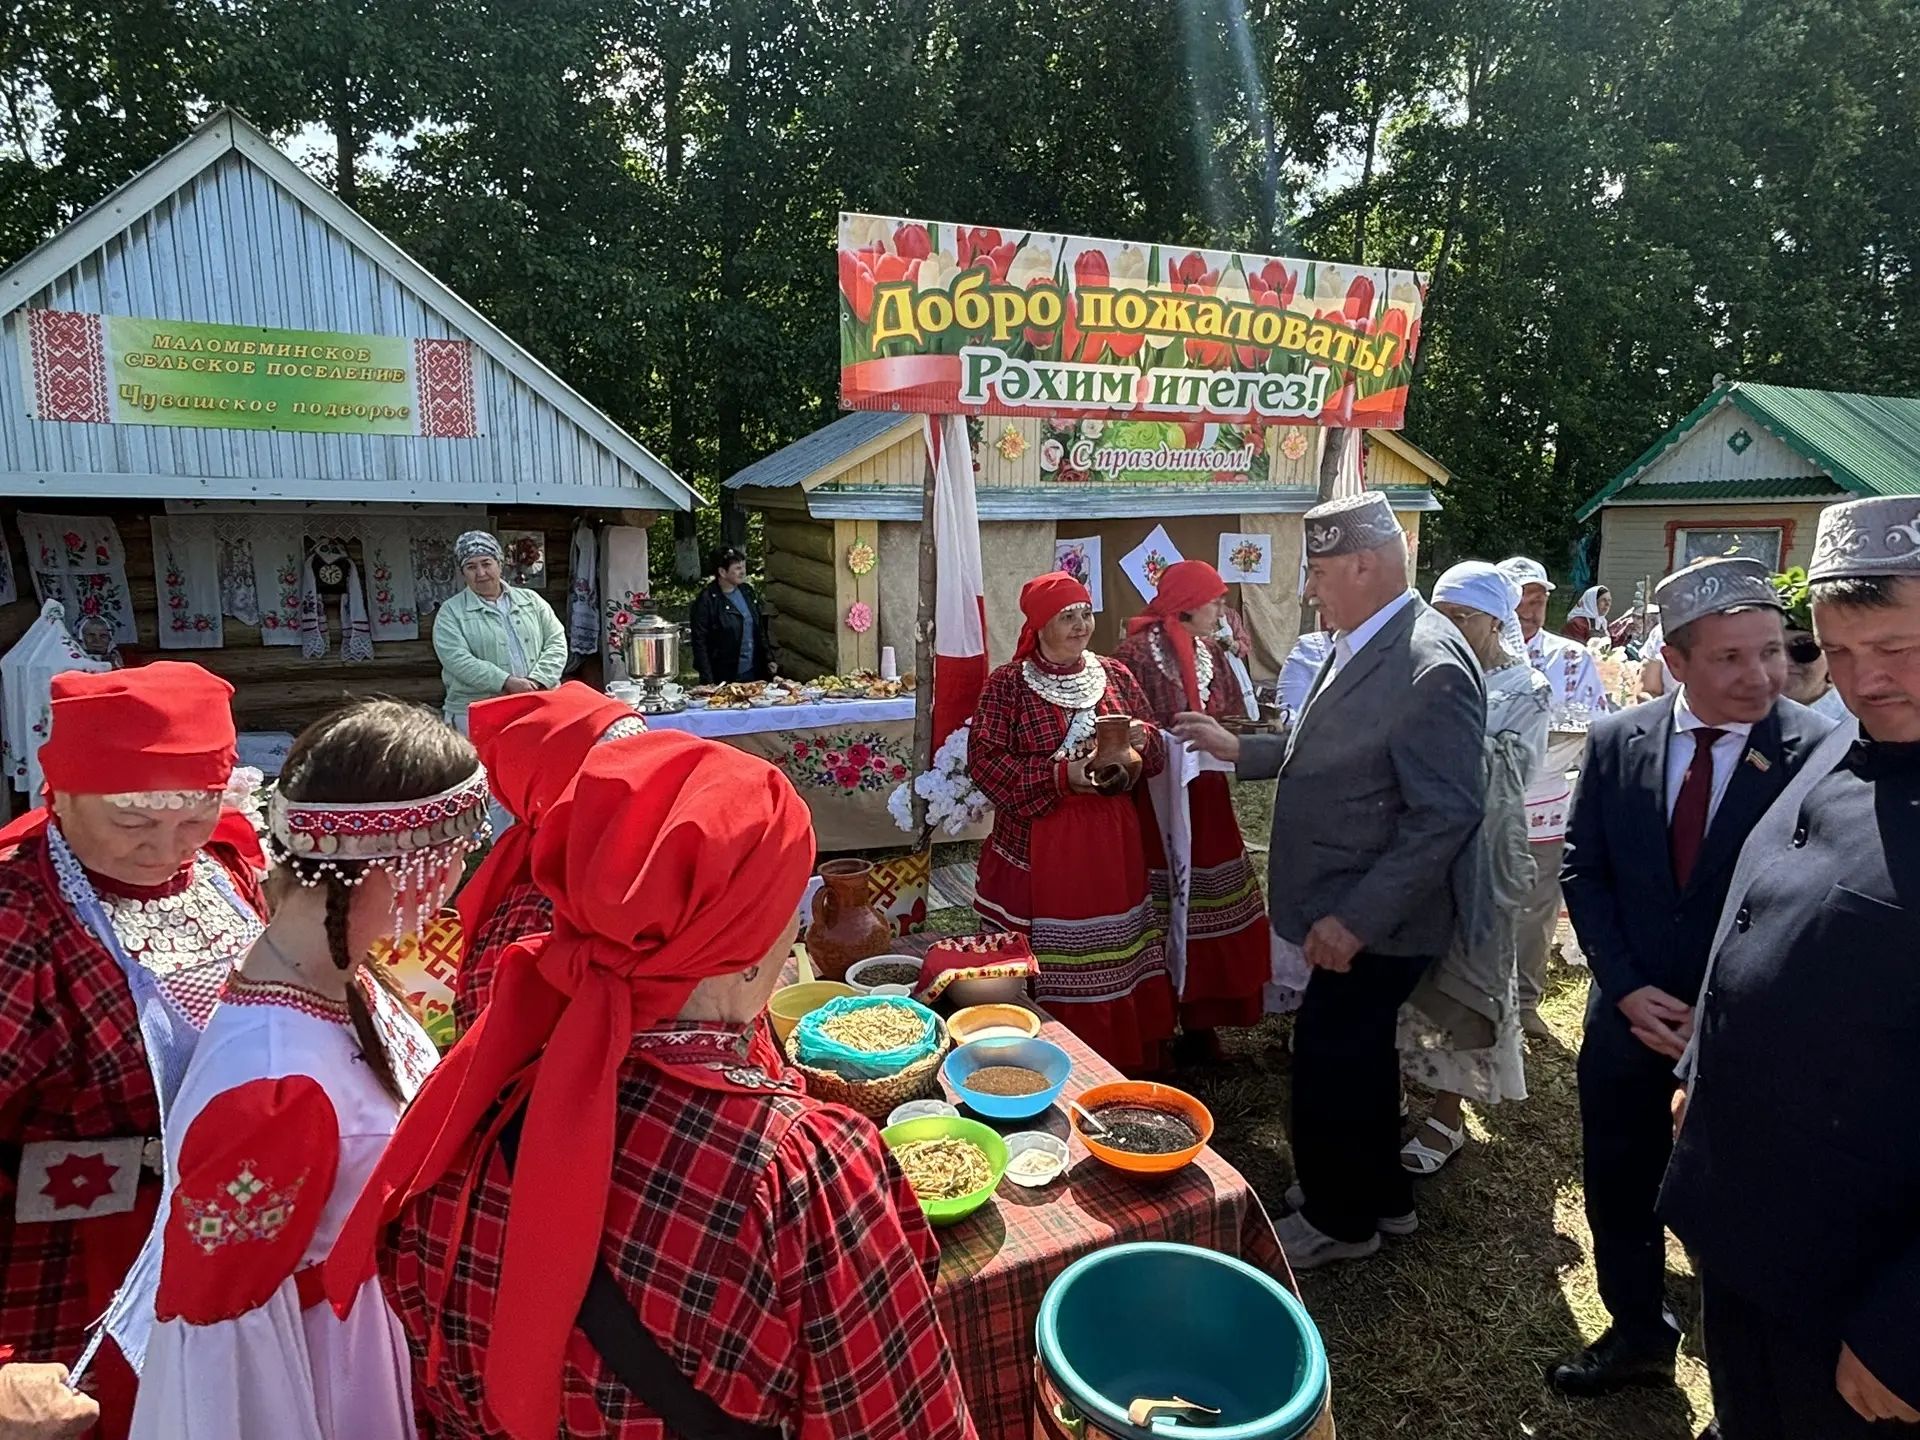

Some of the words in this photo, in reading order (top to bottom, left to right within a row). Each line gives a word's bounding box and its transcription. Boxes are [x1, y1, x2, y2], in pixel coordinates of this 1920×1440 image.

[872, 271, 1062, 352] Добро
[1079, 290, 1396, 379] пожаловать!
[153, 334, 371, 361] МАЛОМЕМИНСКОЕ
[125, 353, 256, 374] СЕЛЬСКОЕ
[266, 362, 405, 382] ПОСЕЛЕНИЕ
[964, 353, 1134, 404] Рәхим
[1152, 373, 1326, 411] итегез!
[120, 385, 277, 411] Чувашское
[292, 401, 409, 421] подворье
[1071, 442, 1093, 468] С
[1097, 441, 1254, 476] праздником!
